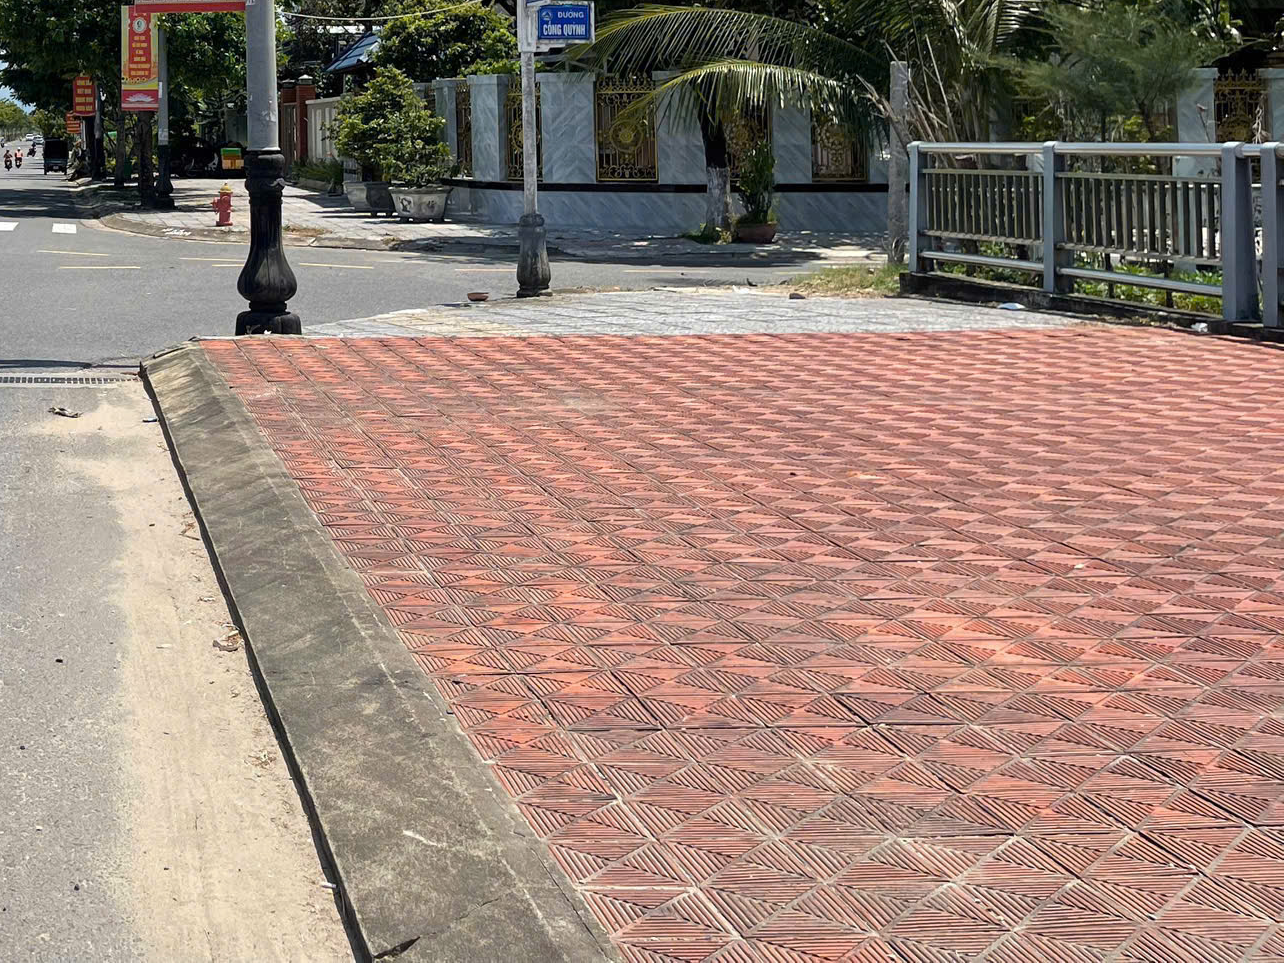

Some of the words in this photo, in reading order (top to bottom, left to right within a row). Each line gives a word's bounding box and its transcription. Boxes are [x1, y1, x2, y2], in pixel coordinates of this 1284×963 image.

[558, 10, 584, 18] ĐƯỜNG
[543, 20, 562, 36] CỐNG
[563, 22, 585, 36] QUỲNH
